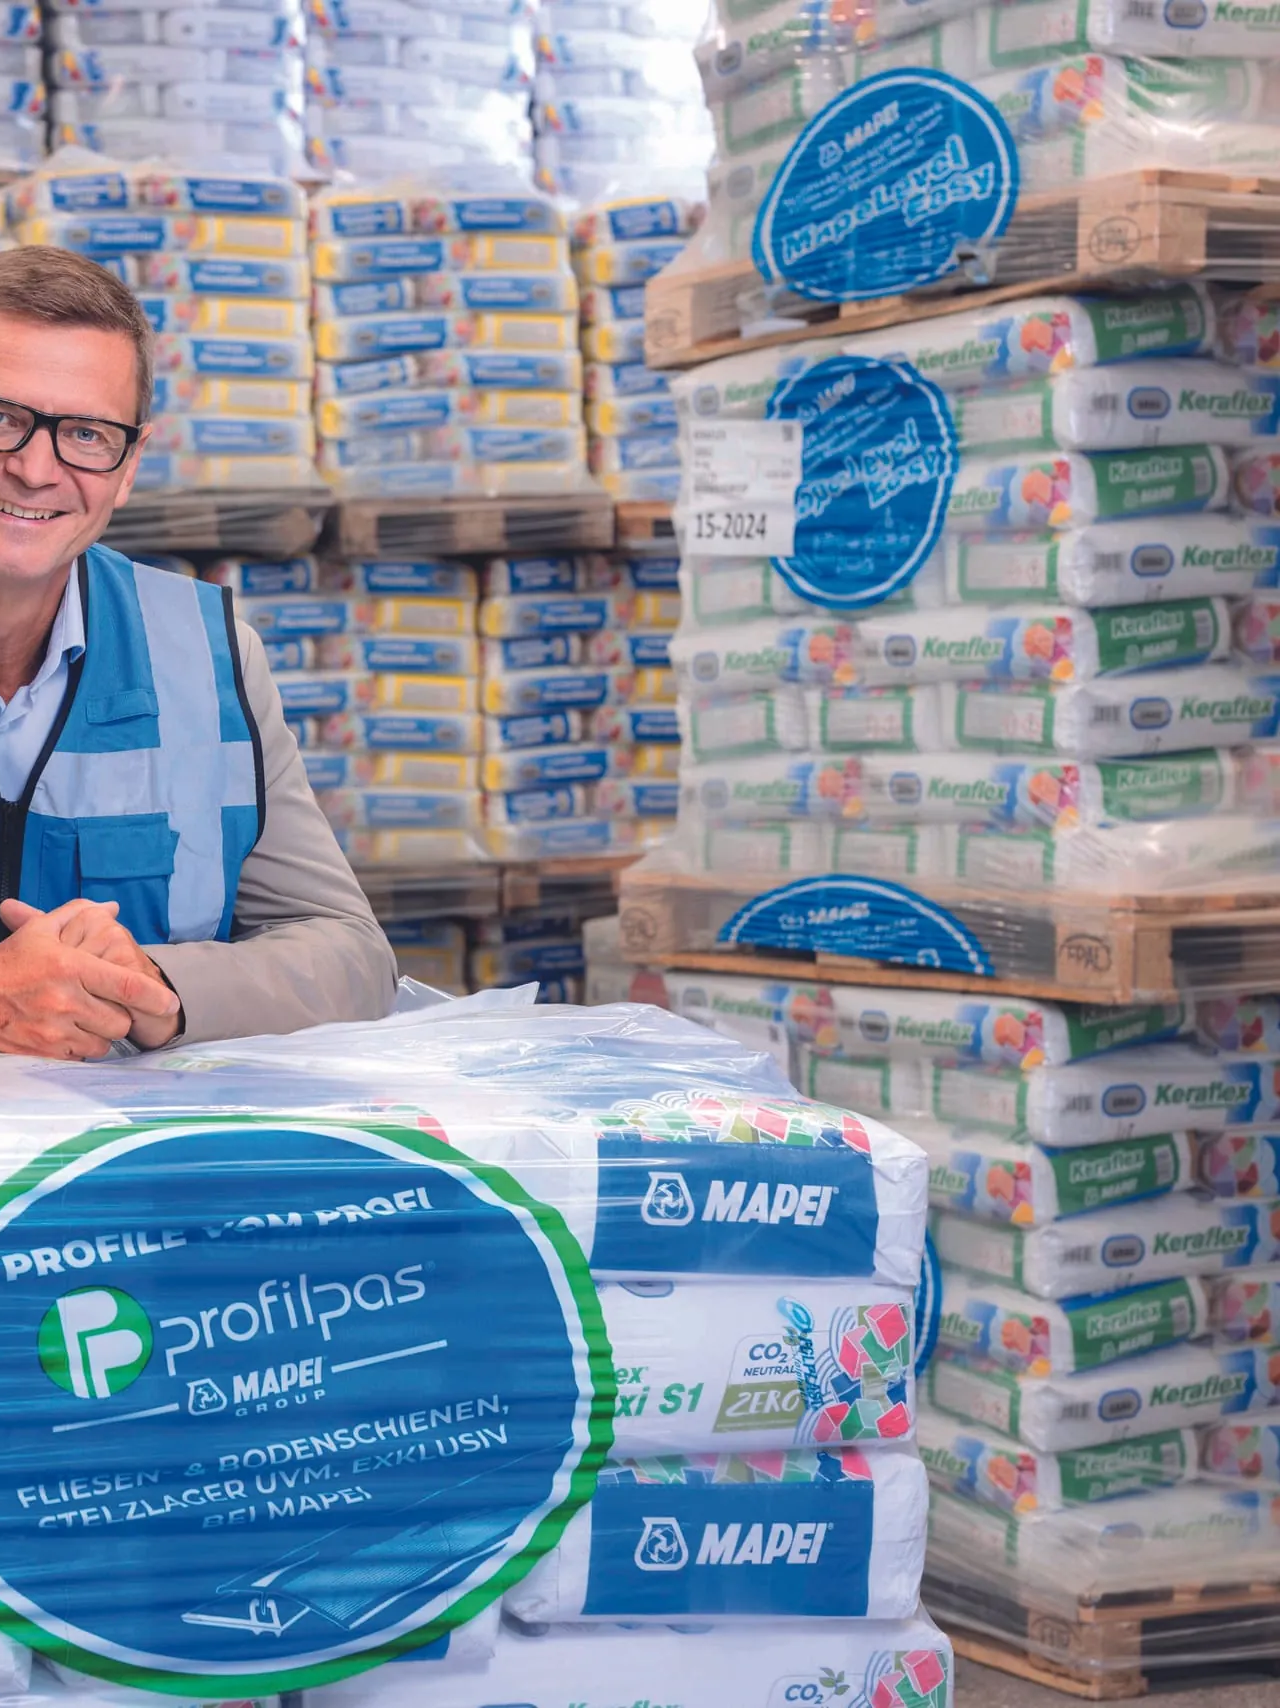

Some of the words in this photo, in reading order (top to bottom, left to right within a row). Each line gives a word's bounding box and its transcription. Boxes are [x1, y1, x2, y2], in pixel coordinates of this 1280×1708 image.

[844, 101, 899, 151] MAPEI
[916, 340, 998, 369] Keraflex
[1179, 389, 1272, 413] Keraflex
[695, 514, 767, 540] 15-2024
[1182, 545, 1274, 568] Keraflex
[922, 637, 1004, 659] Keraflex
[1180, 697, 1273, 720] Keraflex
[927, 777, 1008, 801] Keraflex
[1155, 1083, 1252, 1106] Keraflex
[701, 1180, 834, 1226] MAPEI
[1, 1229, 187, 1282] PROFILE
[313, 1187, 435, 1226] PROFI
[1154, 1226, 1250, 1254] Keraflex
[159, 1264, 426, 1377] profilpas
[1086, 1301, 1162, 1338] Keraflex
[233, 1356, 323, 1403] MAPEI
[743, 1366, 798, 1377] NEUTRAL
[235, 1388, 326, 1417] GROUP
[658, 1382, 705, 1415] S1
[725, 1390, 801, 1418] ZERO
[1149, 1377, 1246, 1406] Keraflex
[184, 1463, 205, 1477] &
[219, 1394, 509, 1472] BODENSCHIENEN,
[38, 1479, 247, 1528] STELZLAGER
[255, 1464, 340, 1494] UVM.
[353, 1424, 508, 1473] EXKLUSIV
[202, 1506, 256, 1528] BEI
[267, 1486, 372, 1519] MAPEI
[696, 1522, 826, 1565] MAPEI
